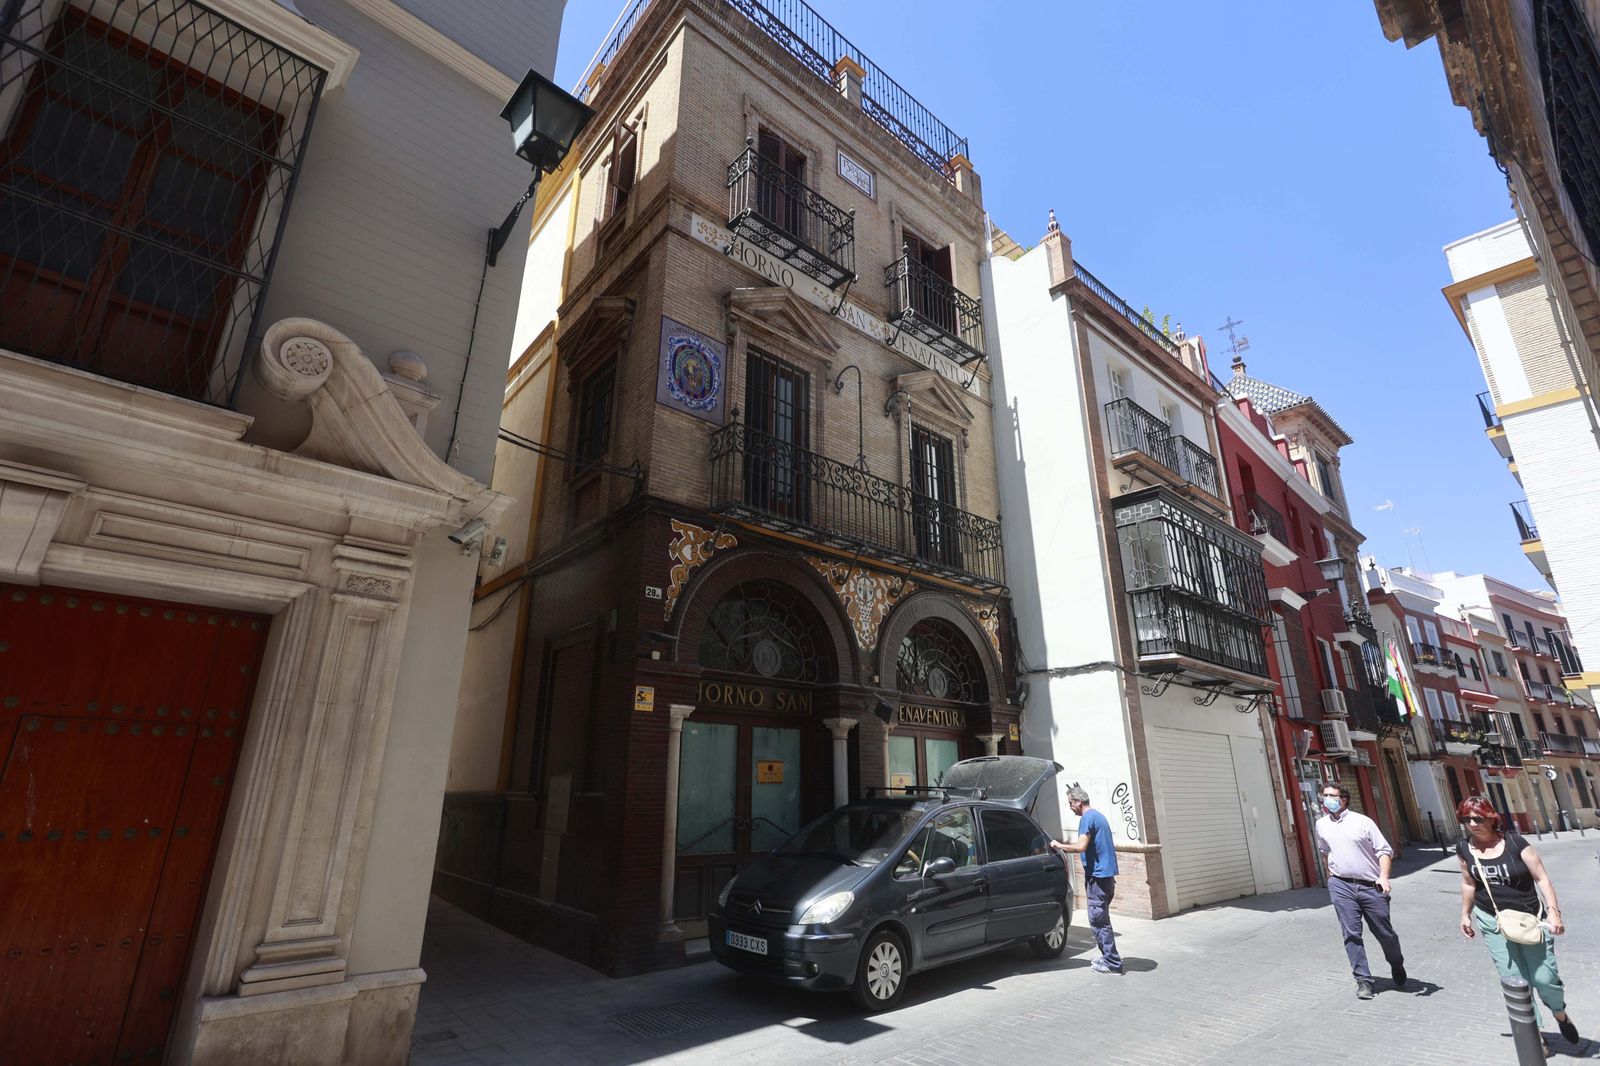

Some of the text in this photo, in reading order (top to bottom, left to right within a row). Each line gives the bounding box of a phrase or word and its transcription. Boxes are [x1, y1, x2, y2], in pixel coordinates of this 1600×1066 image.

[730, 241, 794, 289] HORNO
[838, 301, 866, 331] SAN
[750, 938, 766, 953] CXS
